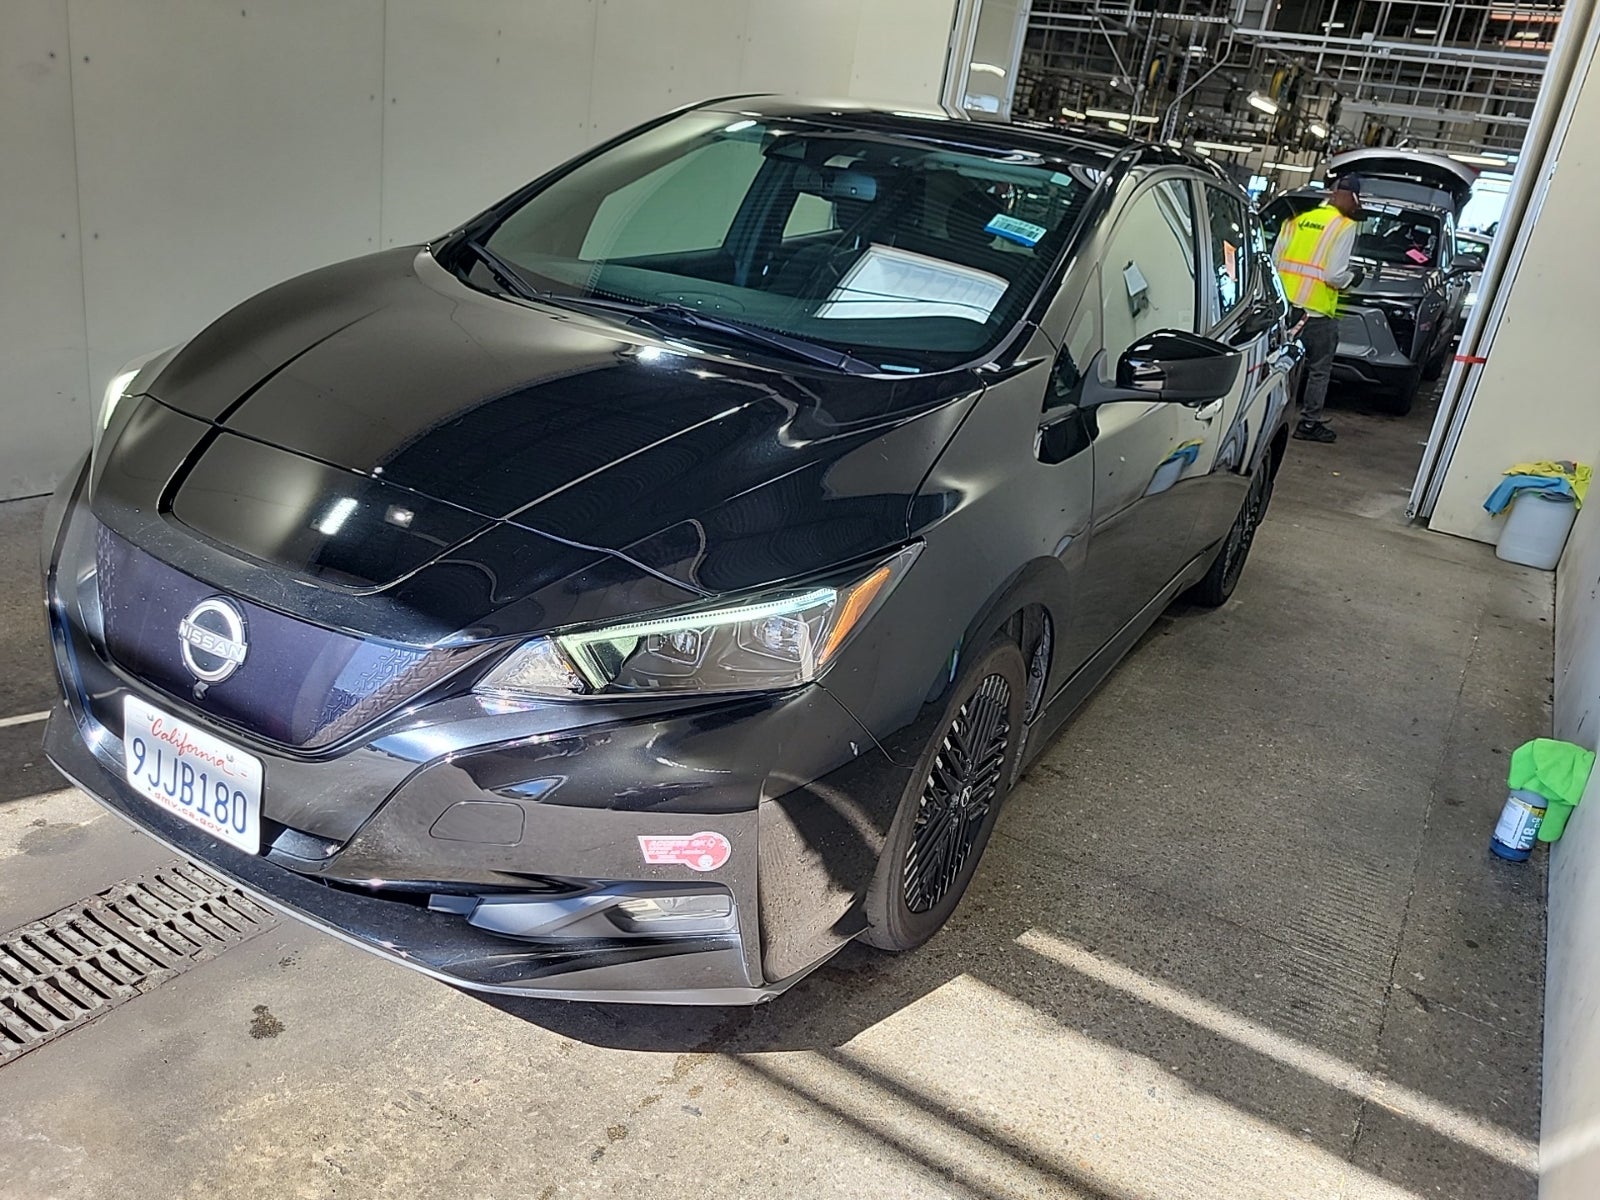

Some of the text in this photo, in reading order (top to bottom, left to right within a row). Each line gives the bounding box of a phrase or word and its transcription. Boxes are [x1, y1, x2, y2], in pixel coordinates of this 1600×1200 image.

[180, 620, 246, 662] NISSAN
[151, 718, 235, 776] California
[132, 737, 247, 834] 9JJB180
[154, 792, 222, 832] dmv.ca.gov
